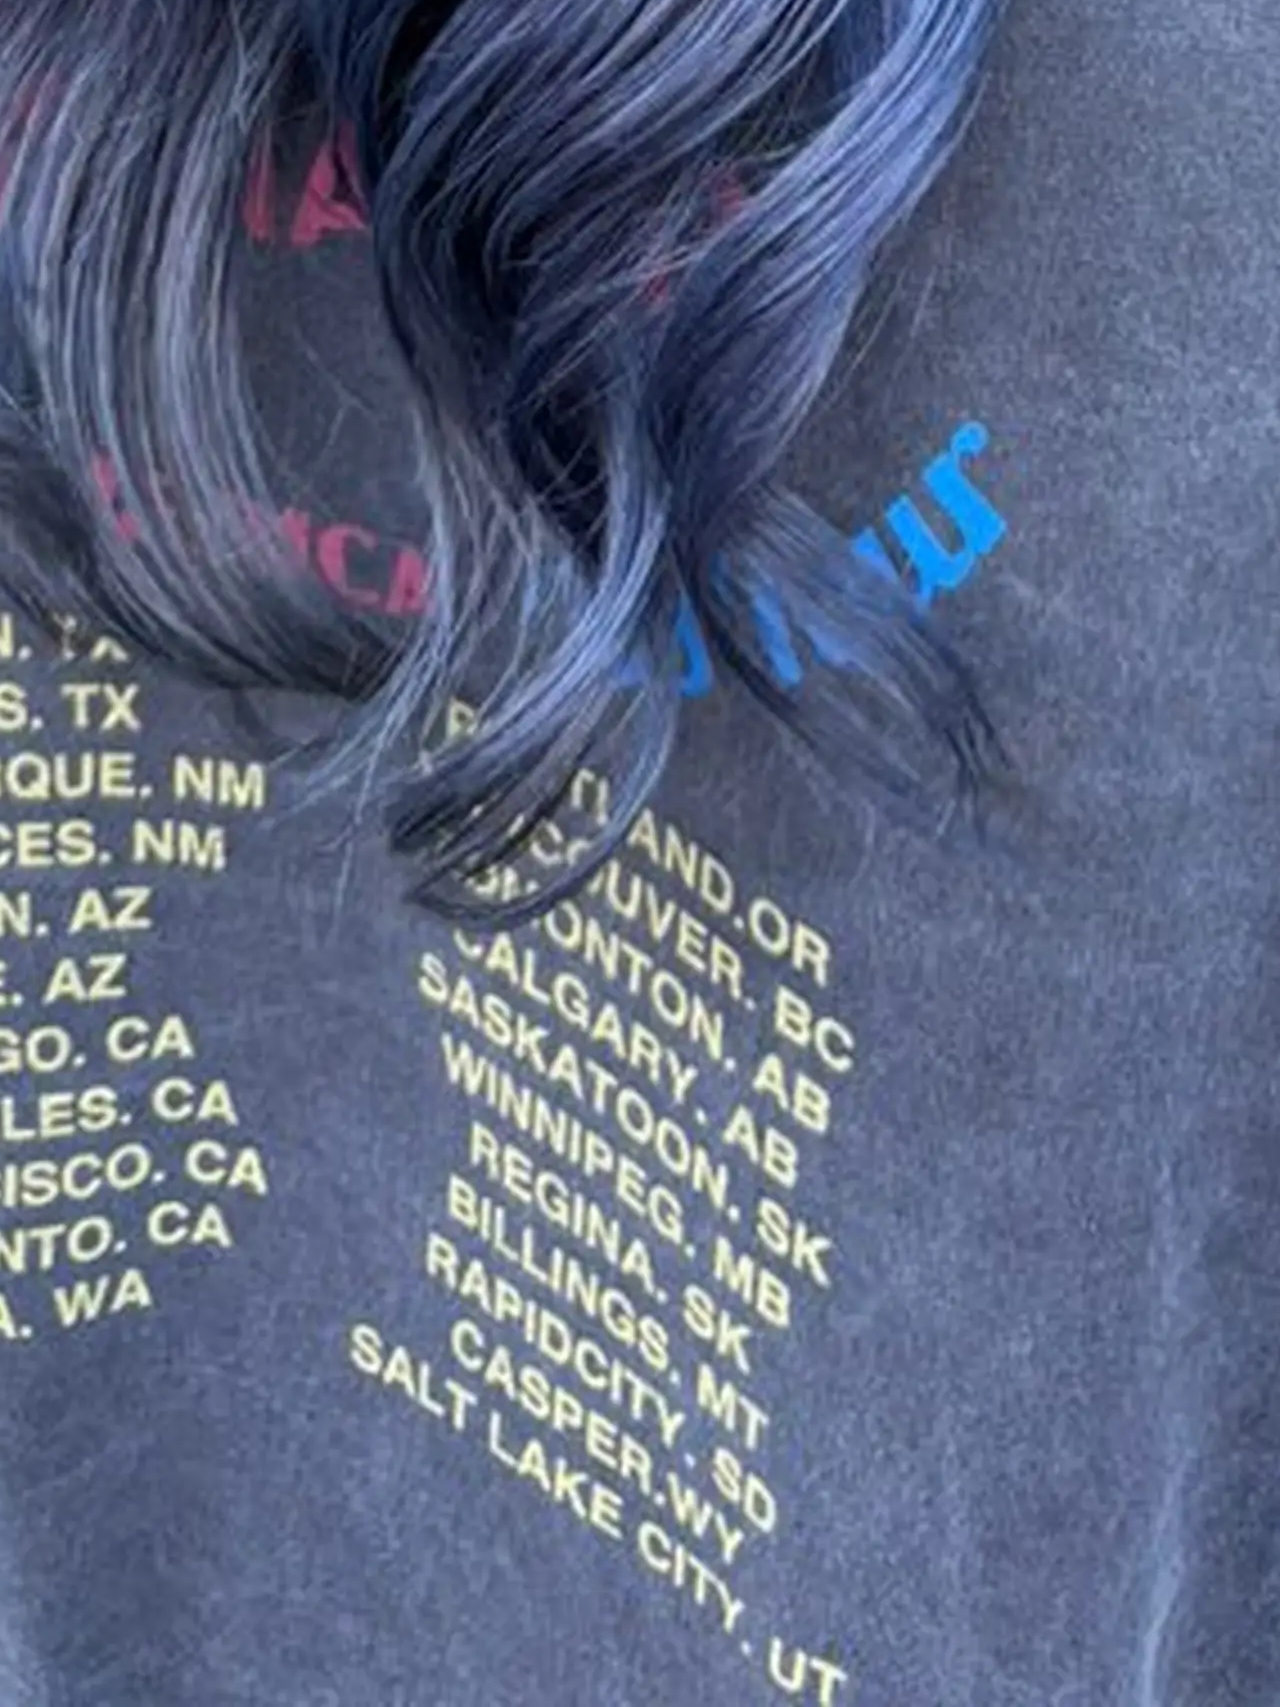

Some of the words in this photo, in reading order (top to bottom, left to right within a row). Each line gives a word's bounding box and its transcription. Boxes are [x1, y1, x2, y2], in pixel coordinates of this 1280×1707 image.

[60, 682, 142, 731] TX
[173, 754, 266, 811] NM
[131, 818, 226, 871] NM
[69, 886, 152, 934] AZ
[42, 952, 127, 1005] AZ
[106, 1014, 195, 1062] CA
[775, 986, 856, 1074] BC
[152, 1076, 238, 1127] CA
[752, 1053, 831, 1135] AB
[185, 1139, 268, 1196] CA
[723, 1105, 799, 1188] AB
[147, 1200, 232, 1251] CA
[755, 1198, 832, 1287] SK
[52, 1269, 153, 1328] WA
[714, 1236, 790, 1329] MB
[682, 1284, 751, 1375] SK
[697, 1363, 770, 1451] MT
[349, 1323, 479, 1430] SALT
[487, 1411, 625, 1538] LAKE
[768, 1635, 848, 1707] UT
[711, 1446, 777, 1532] SD
